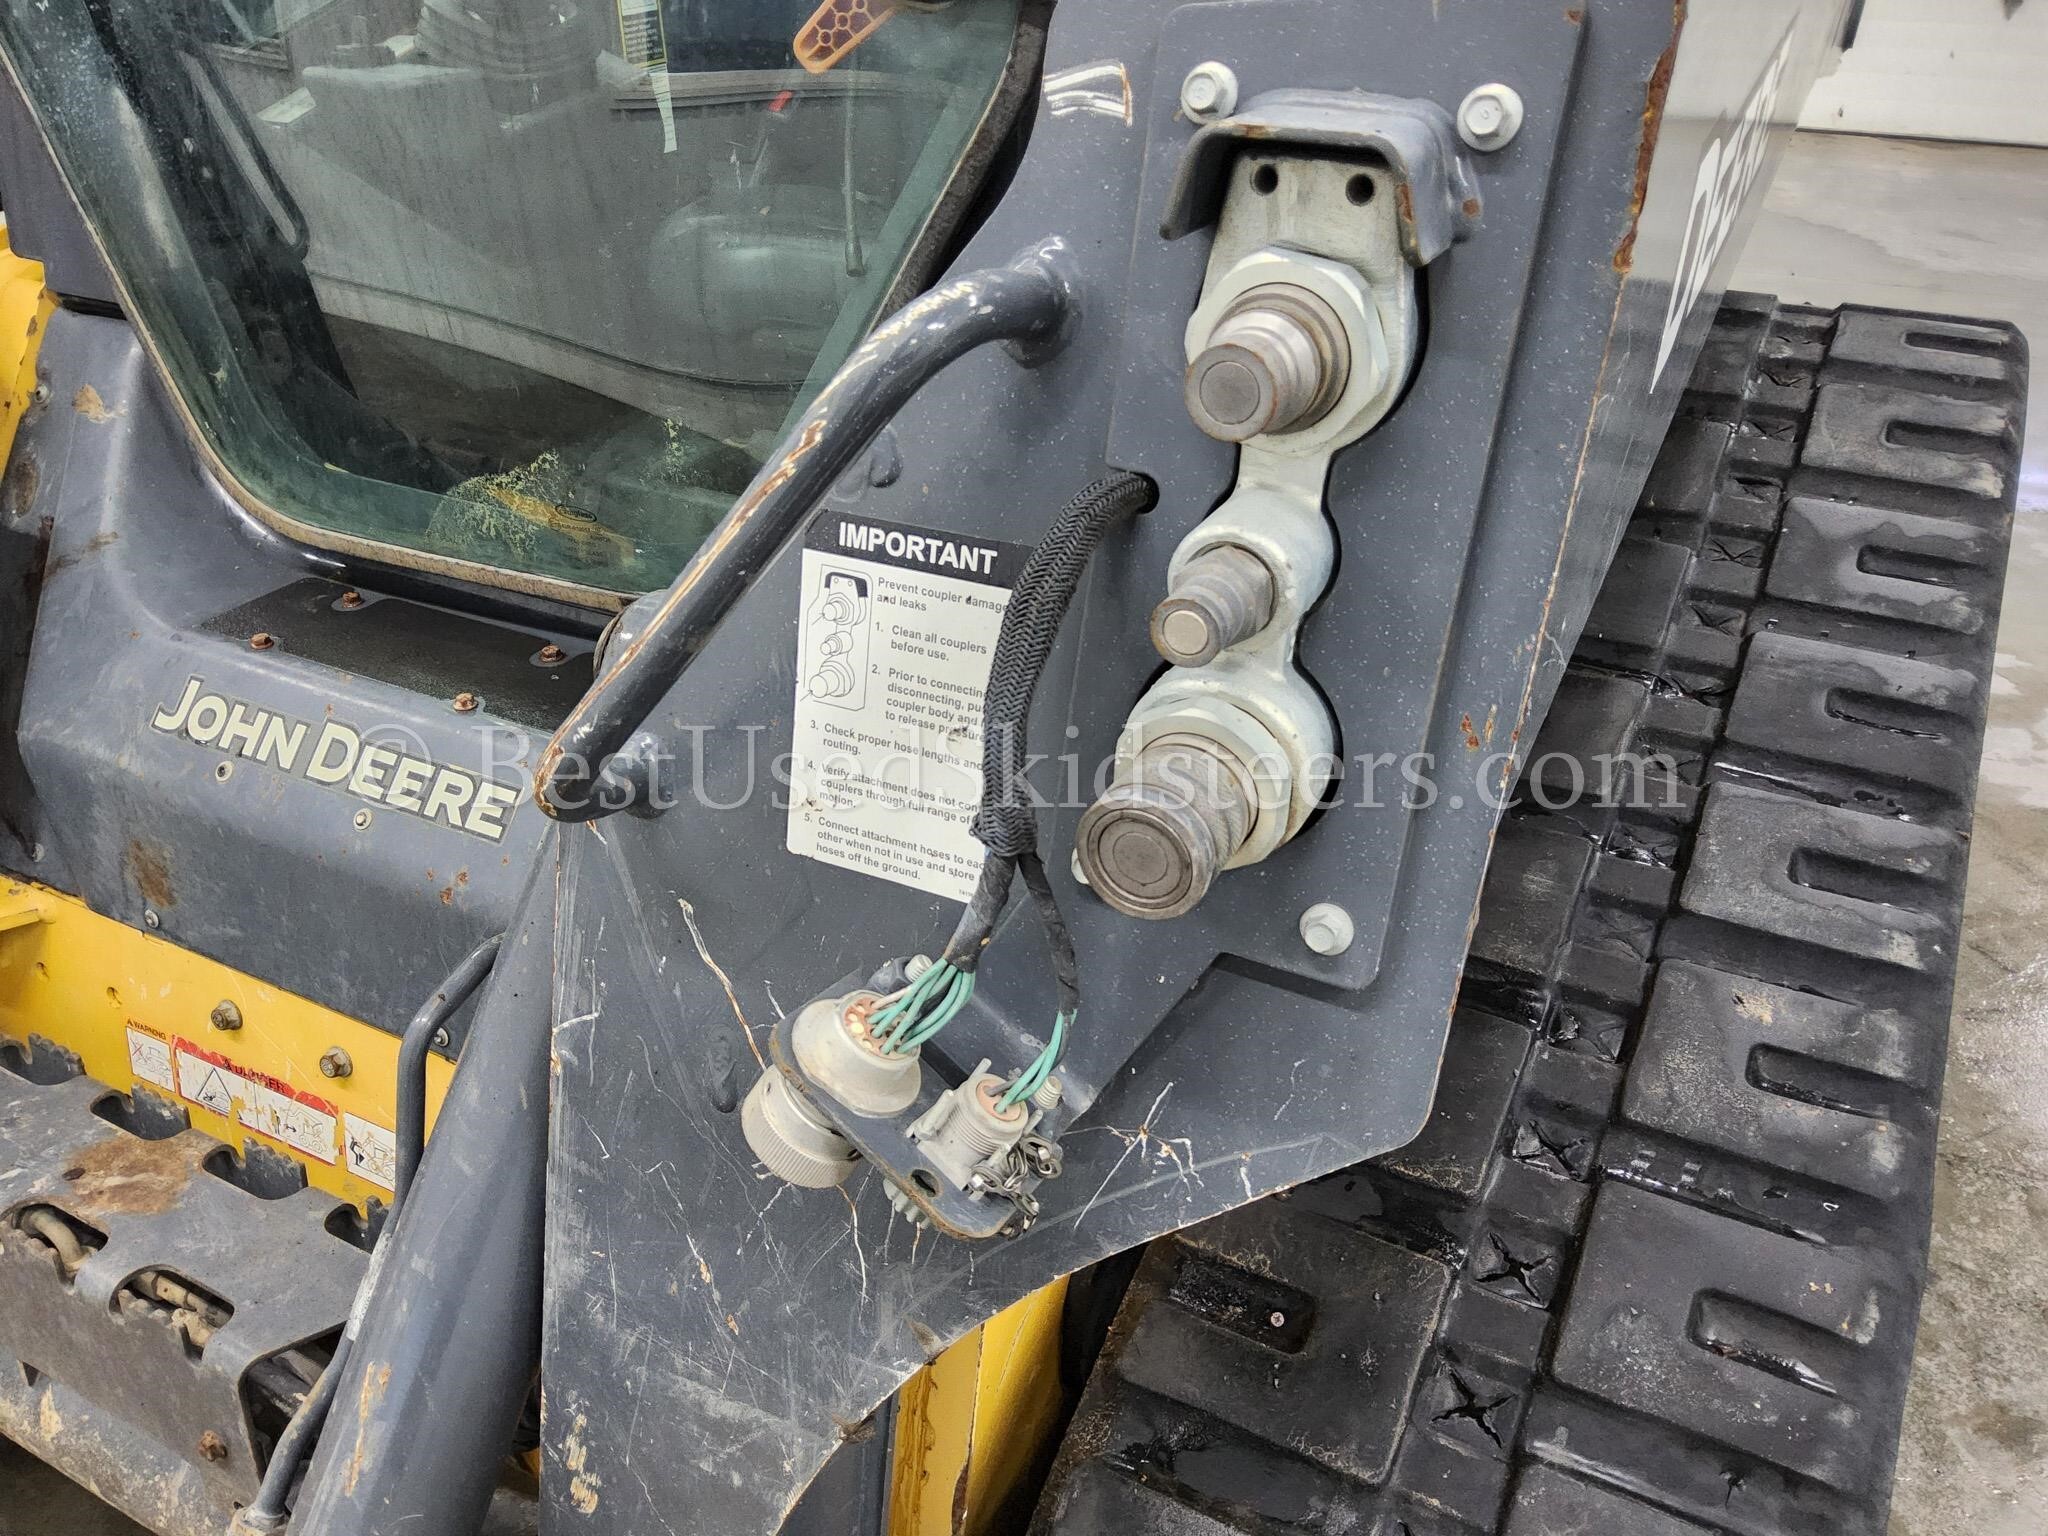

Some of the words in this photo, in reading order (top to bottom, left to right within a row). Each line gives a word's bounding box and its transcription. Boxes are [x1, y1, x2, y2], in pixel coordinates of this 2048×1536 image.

[838, 522, 998, 574] IMPORTANT
[877, 594, 896, 605] and
[900, 597, 927, 611] leaks
[878, 577, 918, 594] Prevent
[921, 587, 962, 603] coupler
[876, 622, 884, 632] 1.
[892, 625, 921, 640] Clean
[924, 632, 937, 644] all
[940, 636, 987, 655] couplers
[891, 640, 925, 655] before
[927, 649, 949, 661] use.
[872, 664, 880, 675] 2.
[888, 667, 914, 682] Prior
[917, 675, 927, 685] to
[930, 680, 987, 698] connectin
[885, 710, 895, 721] to
[898, 714, 936, 730] release
[887, 698, 926, 714] coupler
[928, 707, 954, 722] body
[957, 714, 978, 726] and
[153, 679, 306, 770] JOHN
[306, 722, 518, 838] DEERE
[810, 720, 818, 730] 3.
[824, 723, 856, 739] Check
[858, 733, 891, 747] proper
[894, 740, 919, 755] hose
[921, 747, 960, 765] lengths
[823, 738, 861, 755] routing.
[808, 760, 816, 770] 4.
[822, 763, 849, 780] Verify
[852, 774, 908, 794] attachment
[911, 787, 935, 801] does
[939, 796, 955, 807] not
[820, 791, 856, 808] motion.
[821, 779, 863, 796] couplers
[866, 789, 906, 808] through
[908, 799, 924, 812] full
[928, 807, 957, 821] range
[960, 814, 970, 824] of
[804, 813, 812, 822] 5.
[818, 816, 859, 835] Connect
[861, 830, 917, 851] attachment
[920, 844, 950, 861] hoses
[954, 854, 964, 864] to
[967, 859, 984, 870] eac
[817, 831, 842, 844] other
[845, 839, 871, 852] when
[874, 847, 890, 858] not
[894, 850, 902, 861] in
[905, 855, 923, 866] use
[927, 861, 945, 872] and
[948, 867, 975, 881] store
[816, 842, 845, 858] hoses
[848, 852, 861, 863] off
[863, 856, 879, 868] the
[882, 862, 920, 880] ground.
